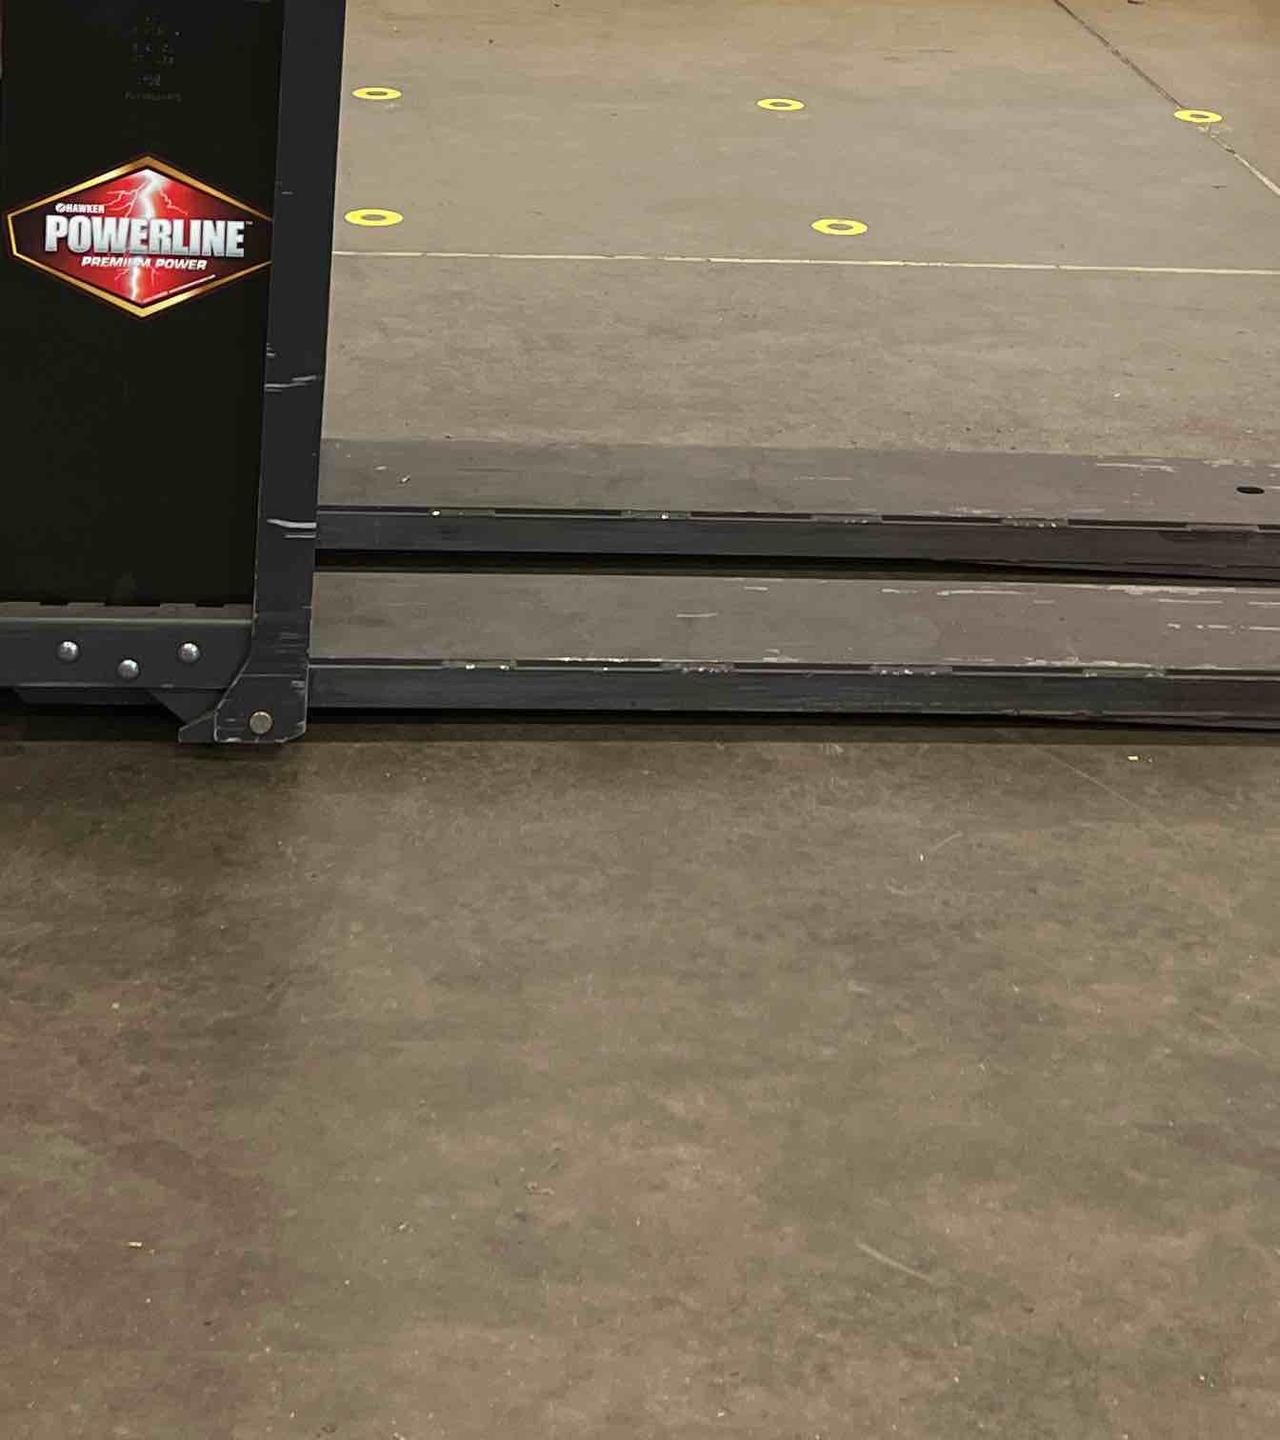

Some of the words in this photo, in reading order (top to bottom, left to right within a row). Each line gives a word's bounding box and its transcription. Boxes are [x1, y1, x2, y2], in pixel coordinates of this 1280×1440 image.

[44, 215, 245, 258] POWERLINE
[80, 256, 151, 268] PREMIUM
[155, 259, 208, 271] POWER
